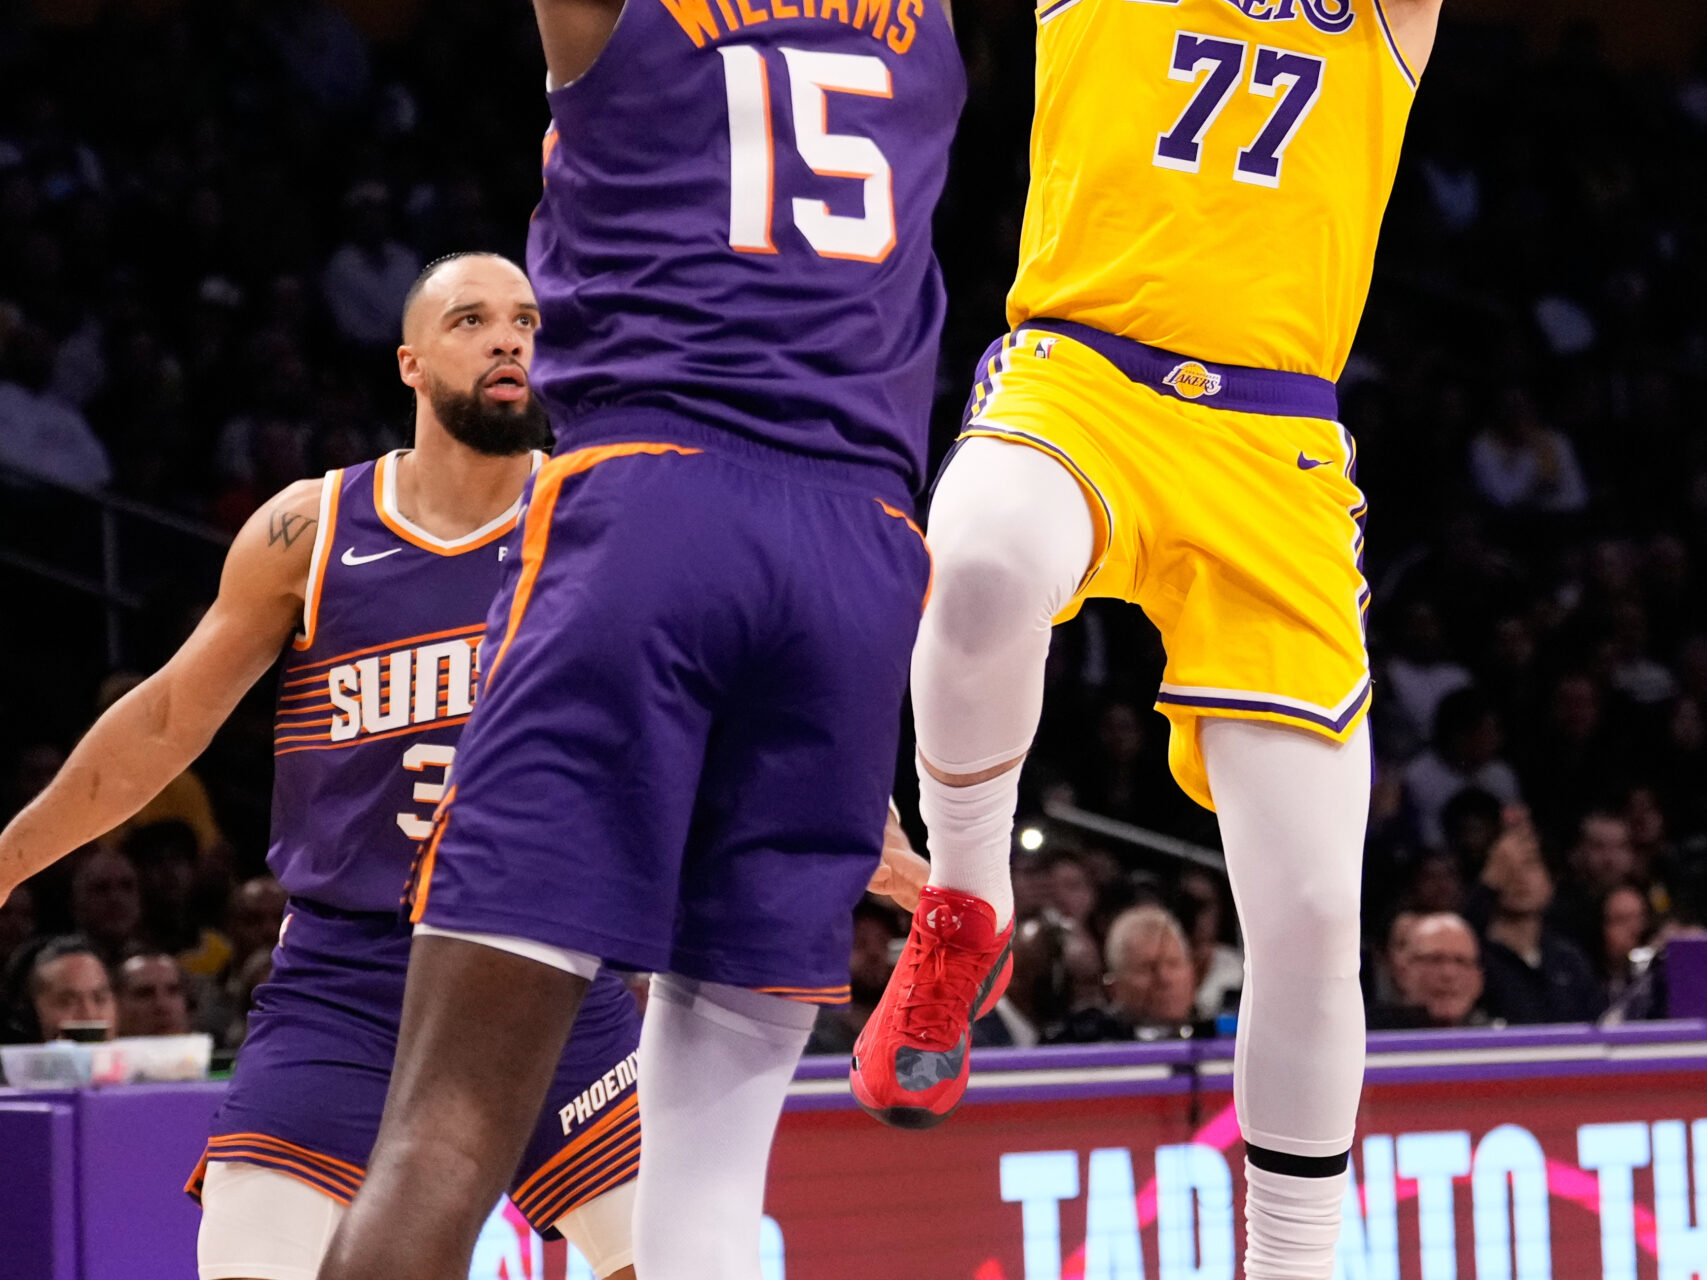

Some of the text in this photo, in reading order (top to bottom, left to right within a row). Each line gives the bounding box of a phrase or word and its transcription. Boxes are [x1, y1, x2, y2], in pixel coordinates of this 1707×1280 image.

[717, 45, 897, 264] 15
[1152, 30, 1326, 189] 77
[1162, 365, 1222, 395] LAKERS
[328, 637, 486, 742] SUN
[396, 743, 457, 840] 3
[558, 1047, 640, 1136] PHOENI
